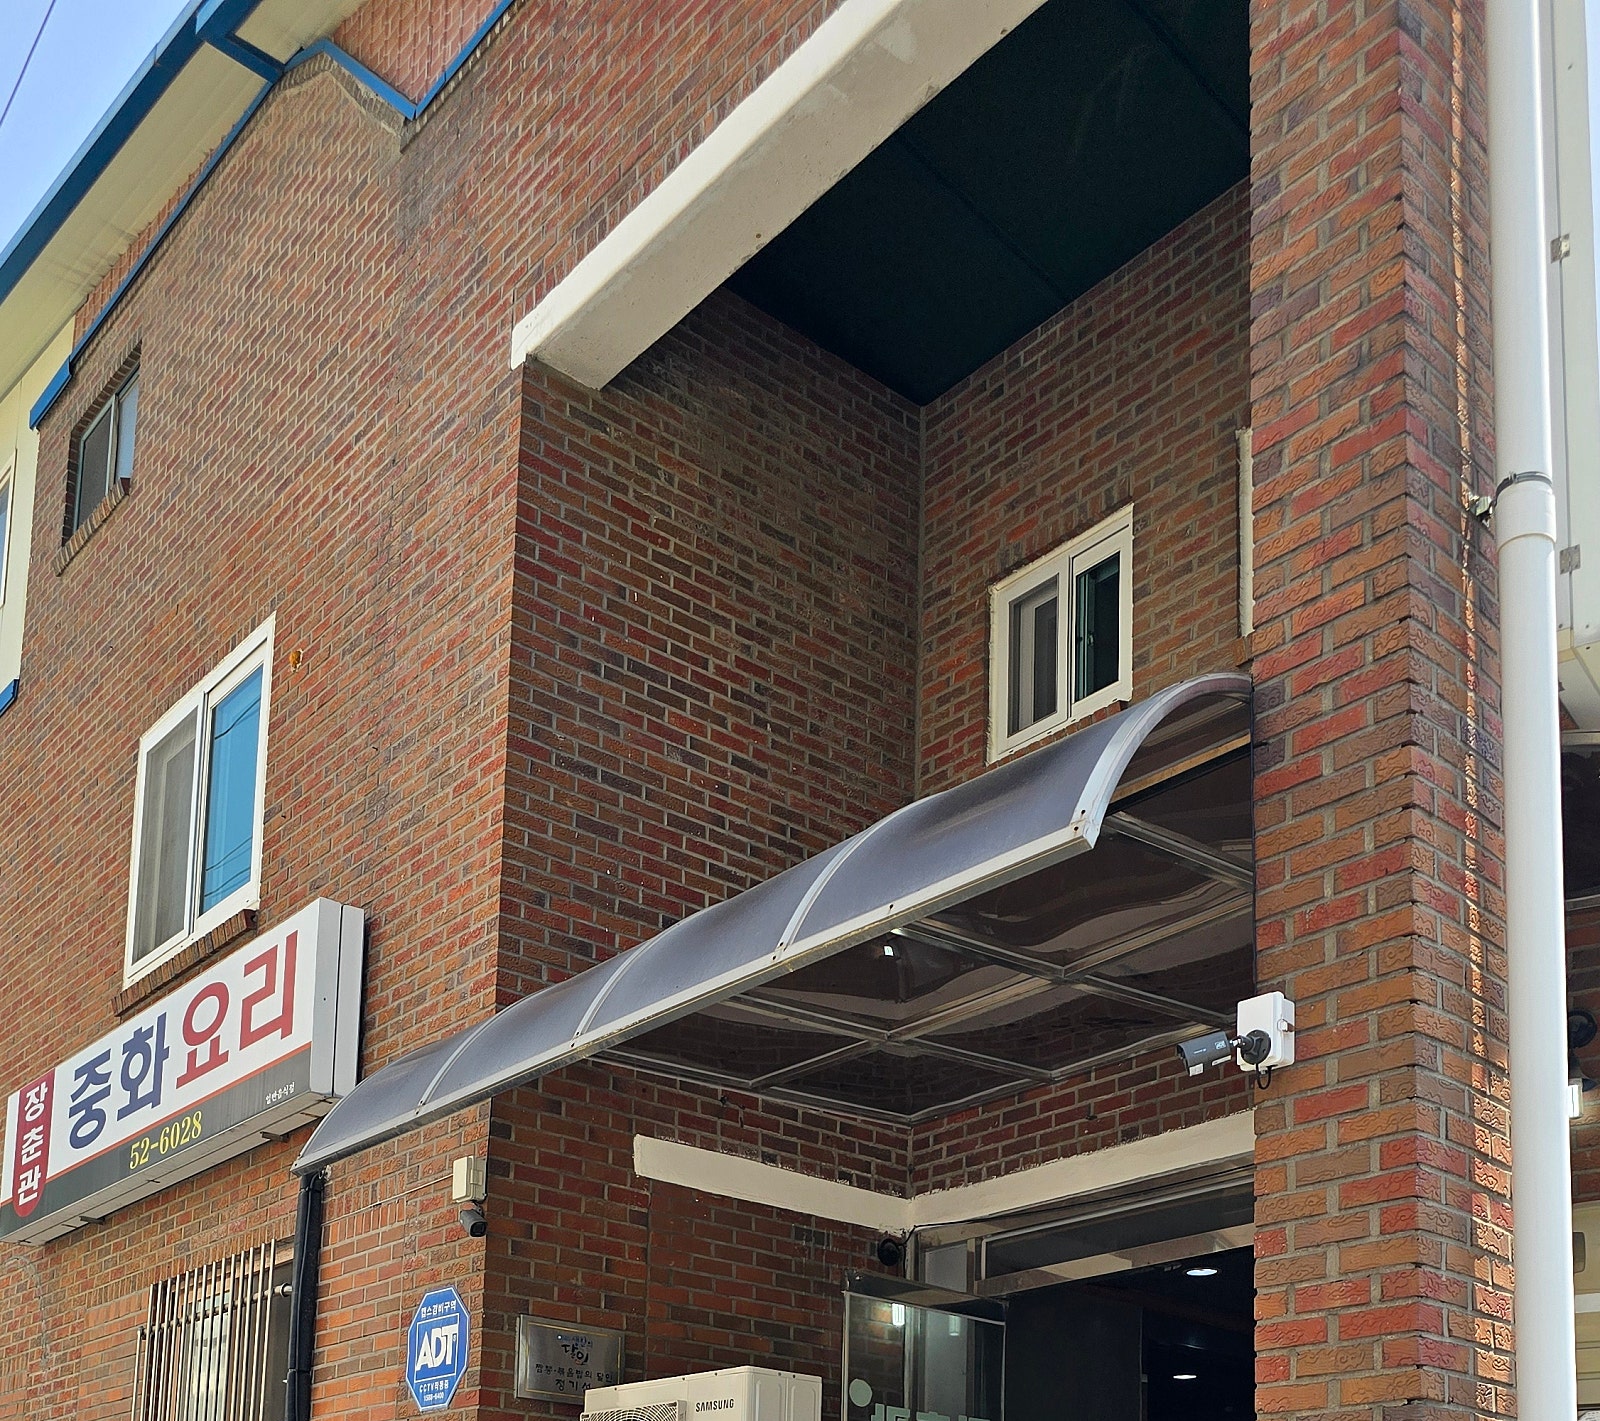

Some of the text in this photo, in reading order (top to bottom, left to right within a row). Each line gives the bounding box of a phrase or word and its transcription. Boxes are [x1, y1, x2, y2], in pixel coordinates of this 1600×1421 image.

[68, 930, 299, 1149] 중화요리
[18, 1081, 48, 1206] 장춘관
[129, 1111, 203, 1170] 52-6028
[416, 1324, 458, 1371] ADT
[597, 1372, 613, 1384] 달인
[695, 1398, 735, 1412] SAMSUNG
